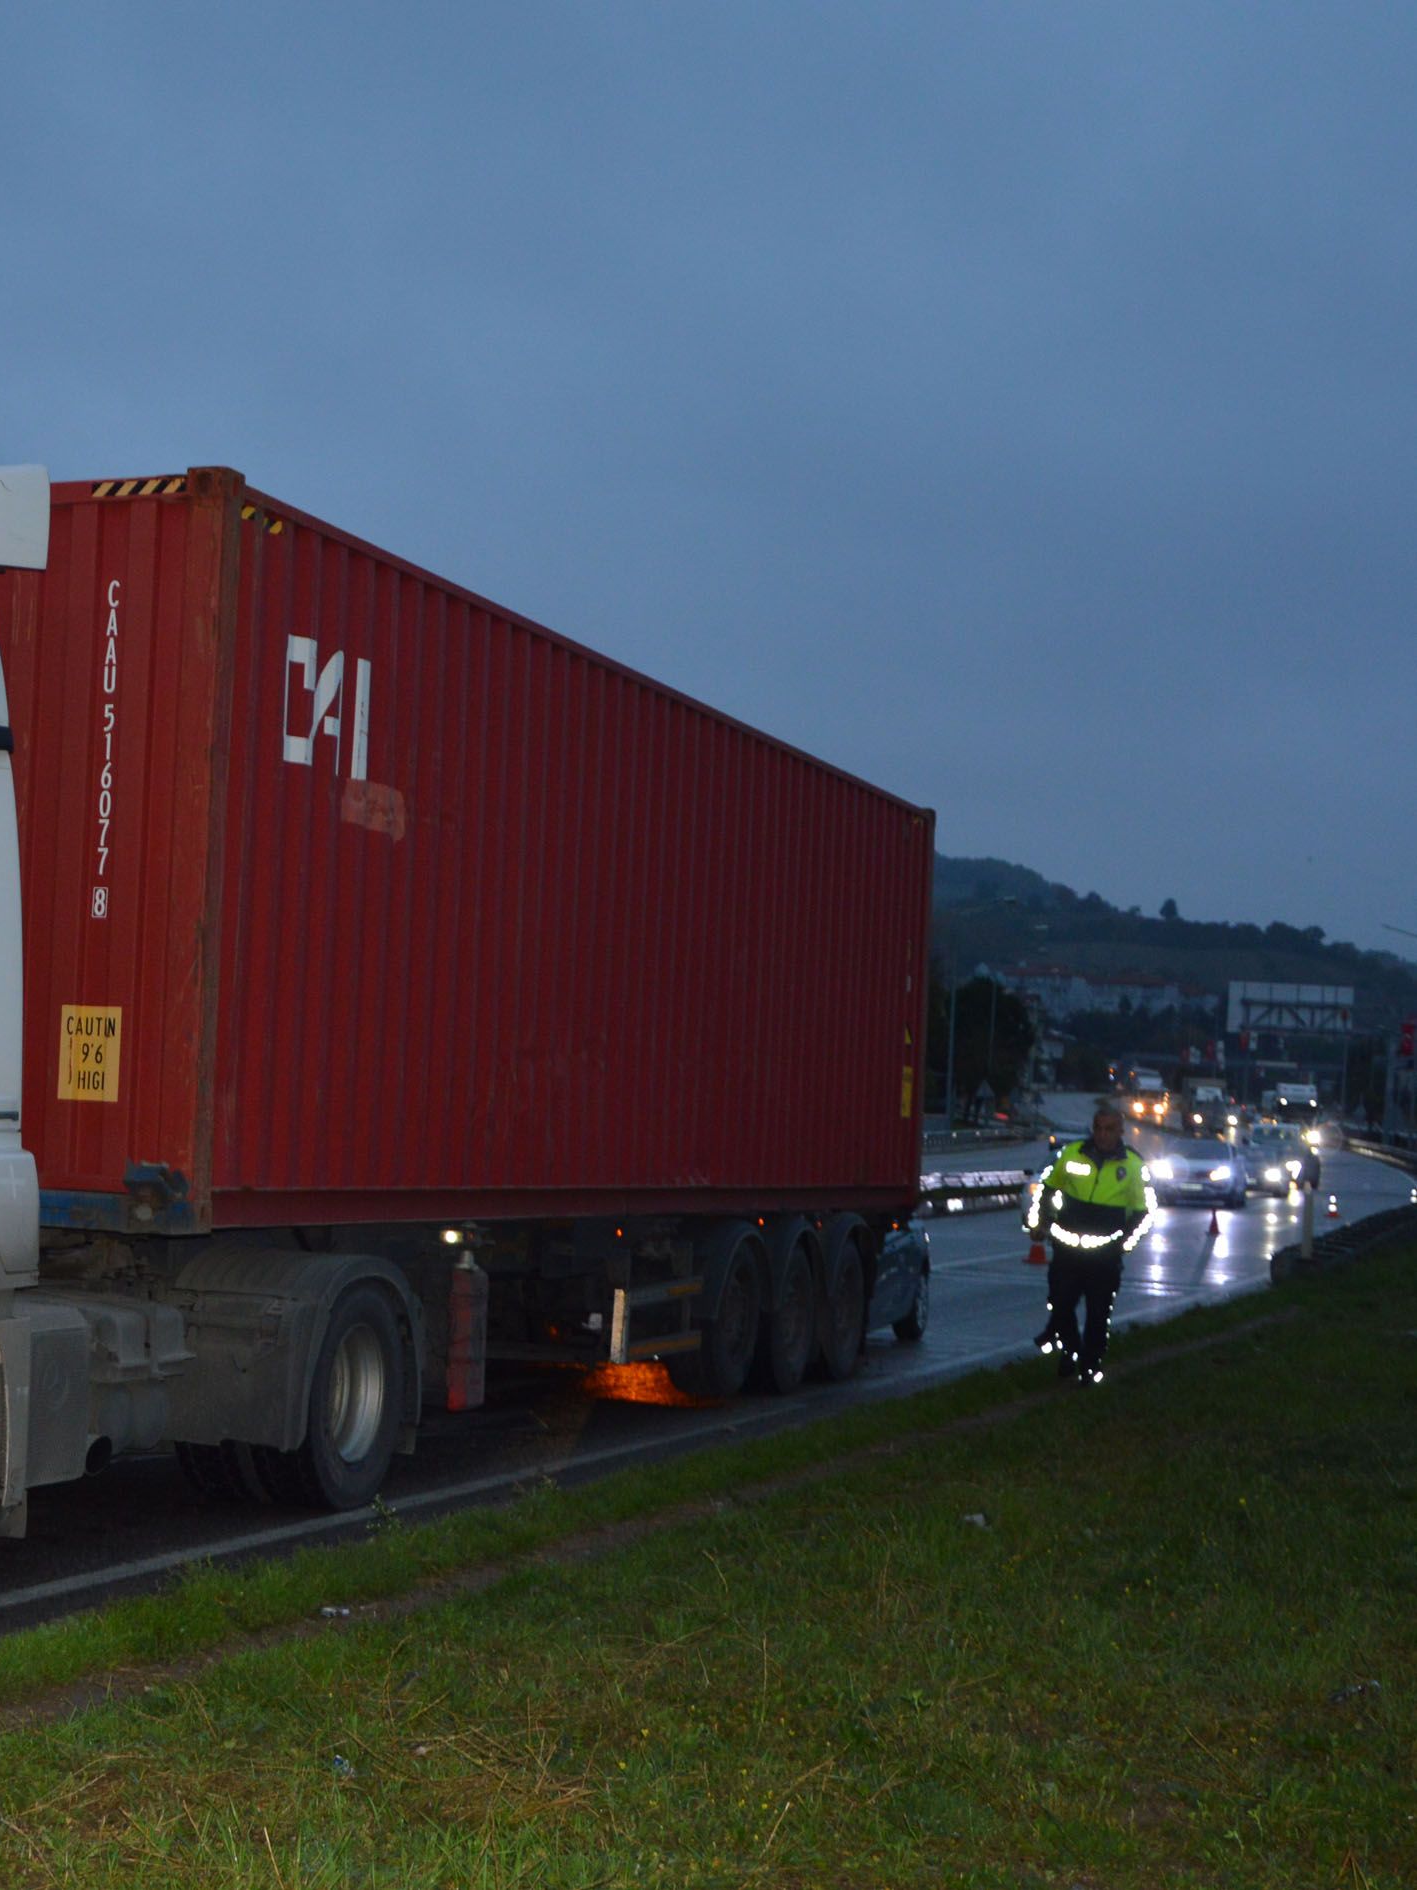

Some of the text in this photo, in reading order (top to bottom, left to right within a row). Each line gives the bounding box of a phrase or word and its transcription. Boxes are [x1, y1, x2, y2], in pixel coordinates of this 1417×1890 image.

[93, 579, 121, 917] CAAU 516077 8
[282, 633, 372, 781] CAI
